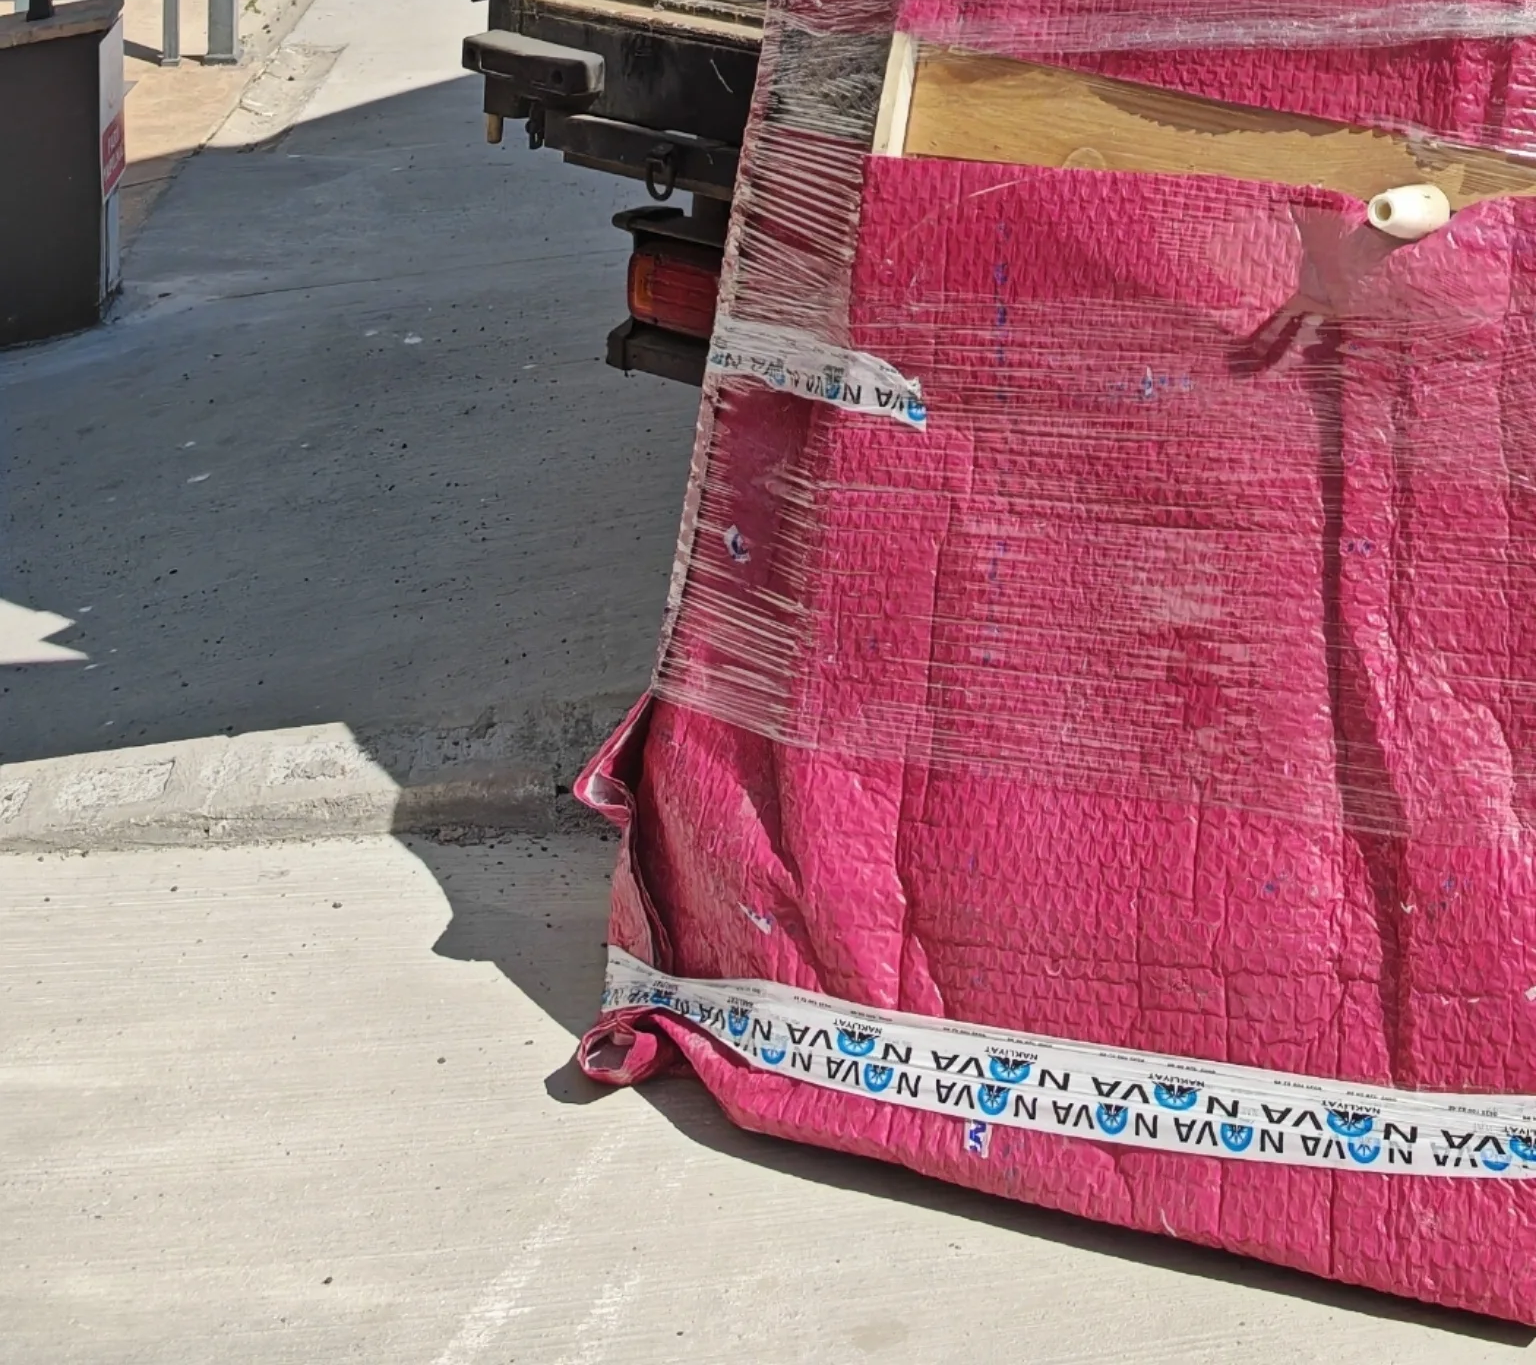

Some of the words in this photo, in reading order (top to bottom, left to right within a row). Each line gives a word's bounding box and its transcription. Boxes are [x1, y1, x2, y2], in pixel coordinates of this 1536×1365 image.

[786, 1022, 914, 1064] NOVA
[825, 1056, 920, 1098] NOVA
[931, 1049, 1070, 1091] NOVA
[935, 1077, 1039, 1121] NOVA
[1051, 1097, 1159, 1139] NOVA
[1092, 1076, 1239, 1119] NOVA
[1173, 1116, 1284, 1155] NOVA
[1261, 1105, 1418, 1143] NOVA
